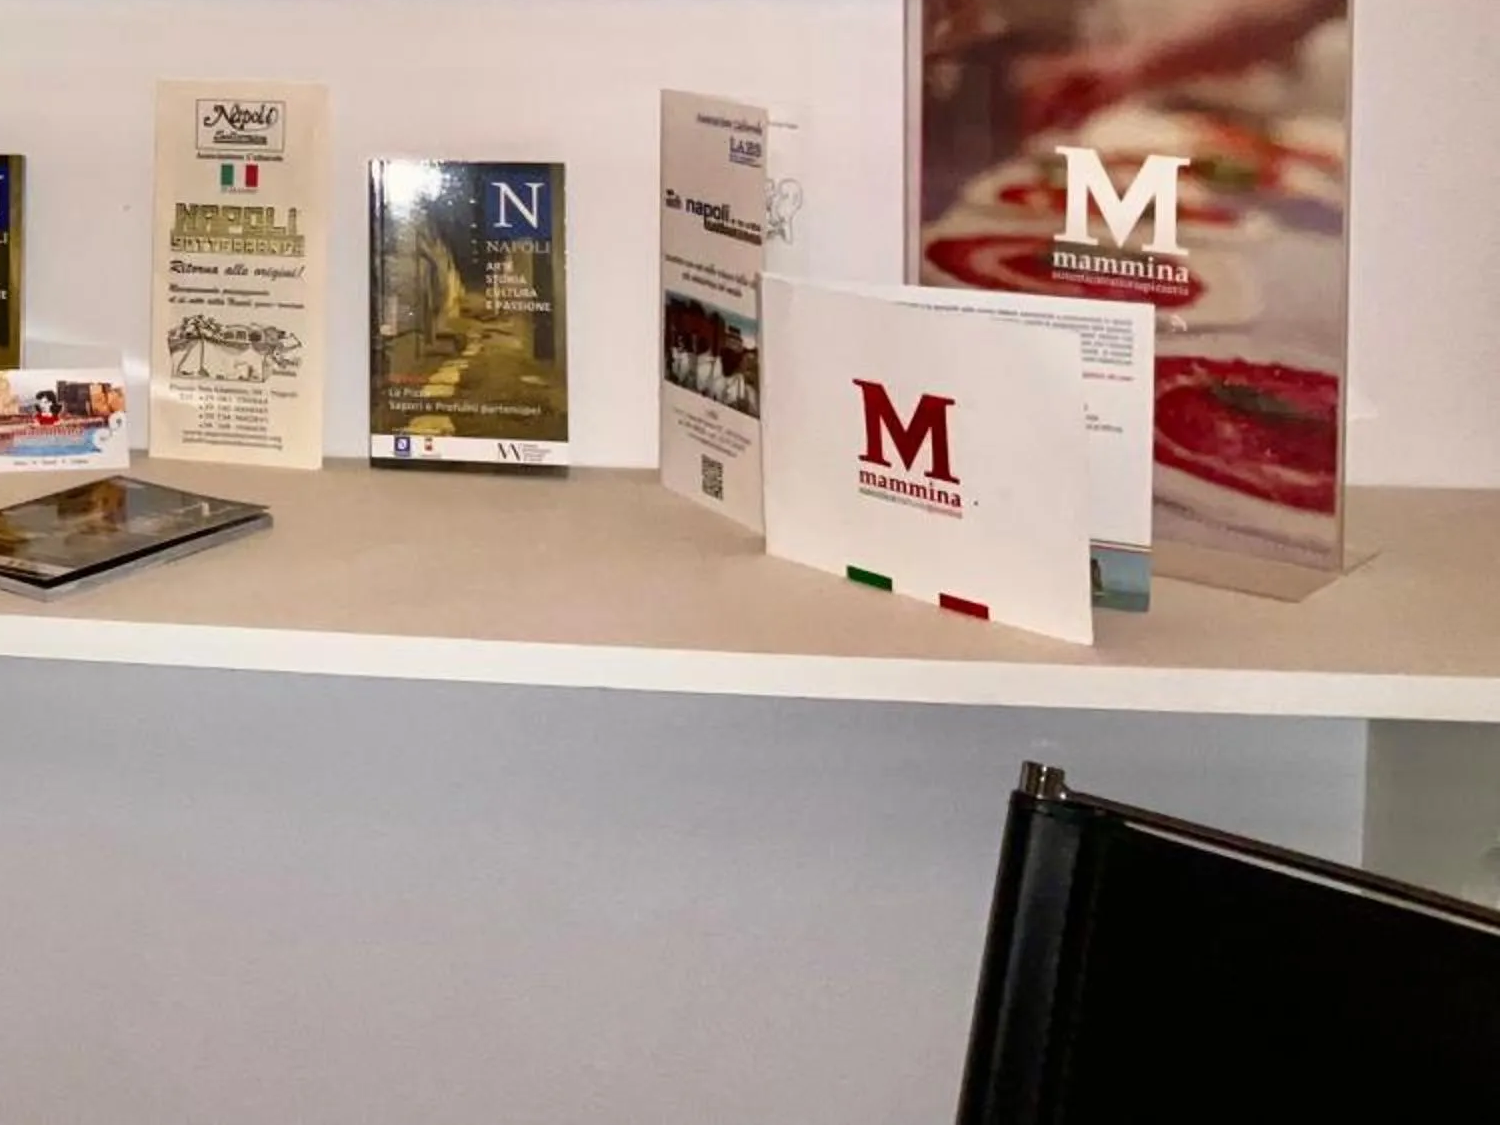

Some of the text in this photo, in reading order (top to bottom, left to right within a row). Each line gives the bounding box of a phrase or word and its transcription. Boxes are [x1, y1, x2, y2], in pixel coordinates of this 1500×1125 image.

[490, 181, 545, 230] N
[685, 198, 731, 222] napoli
[1054, 146, 1191, 255] M
[485, 240, 551, 254] NAPOLI
[1052, 249, 1191, 284] mammina
[853, 378, 961, 485] M
[858, 469, 962, 508] mammina
